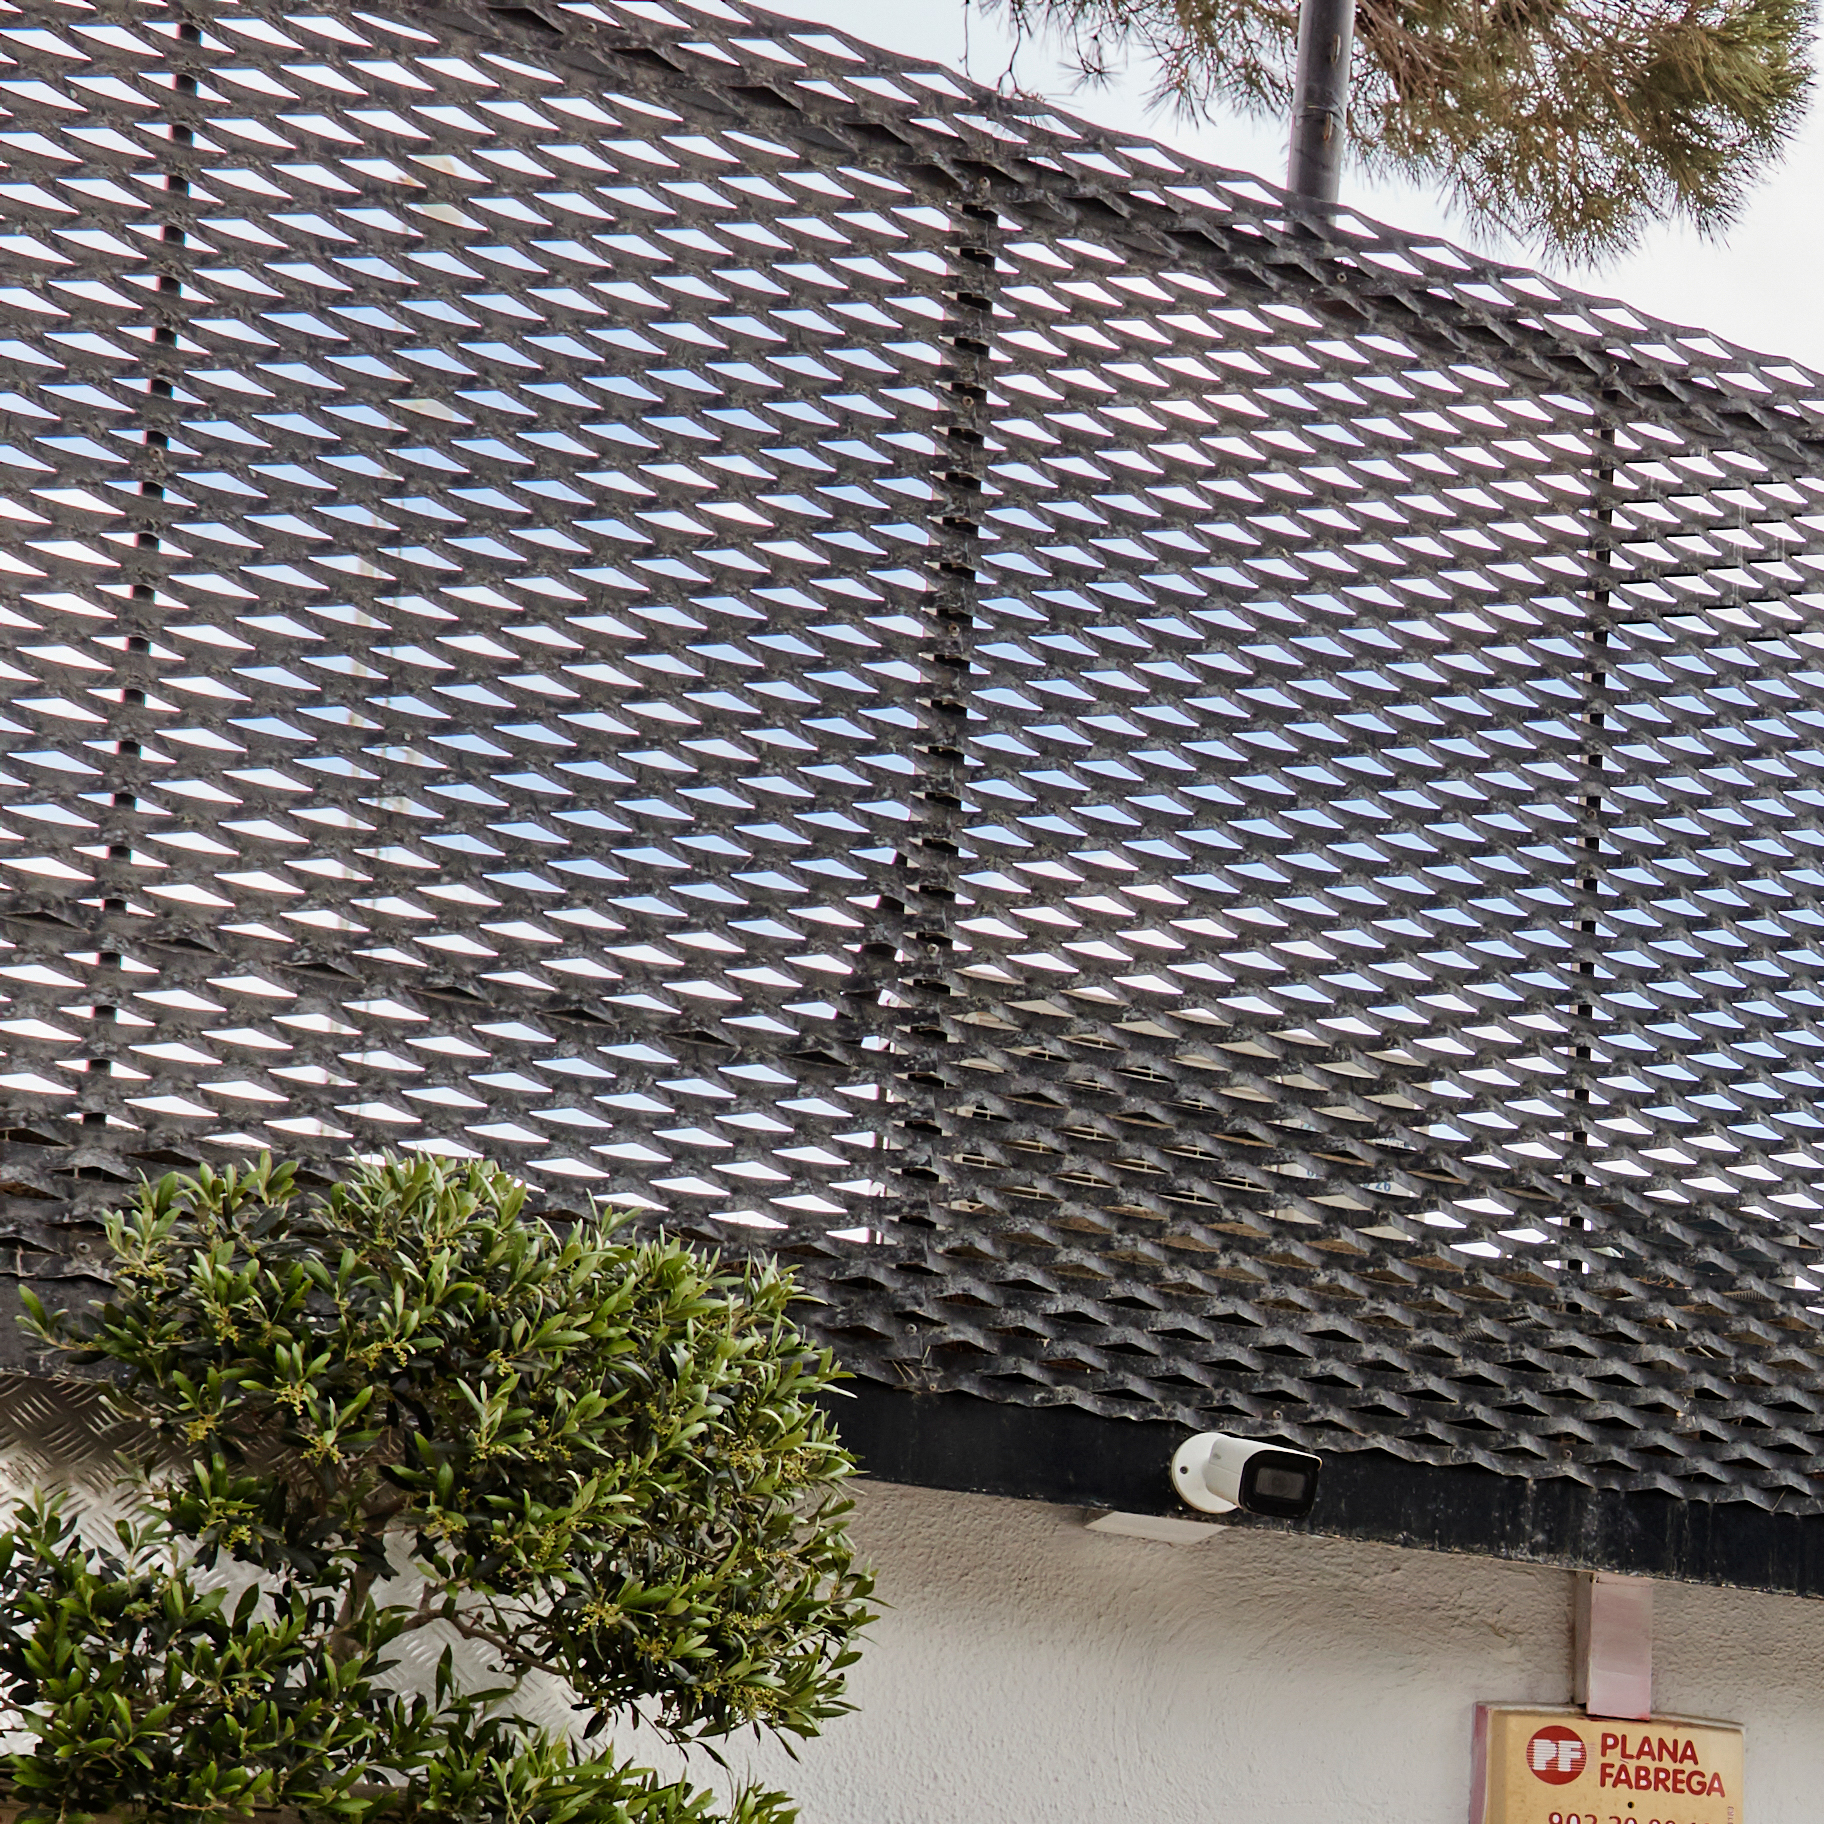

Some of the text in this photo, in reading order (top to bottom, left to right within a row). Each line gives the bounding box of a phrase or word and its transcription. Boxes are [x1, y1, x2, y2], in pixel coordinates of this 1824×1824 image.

[1532, 1739, 1584, 1771] PF
[1601, 1732, 1698, 1766] PLANA
[1600, 1758, 1726, 1798] FÀBREGA
